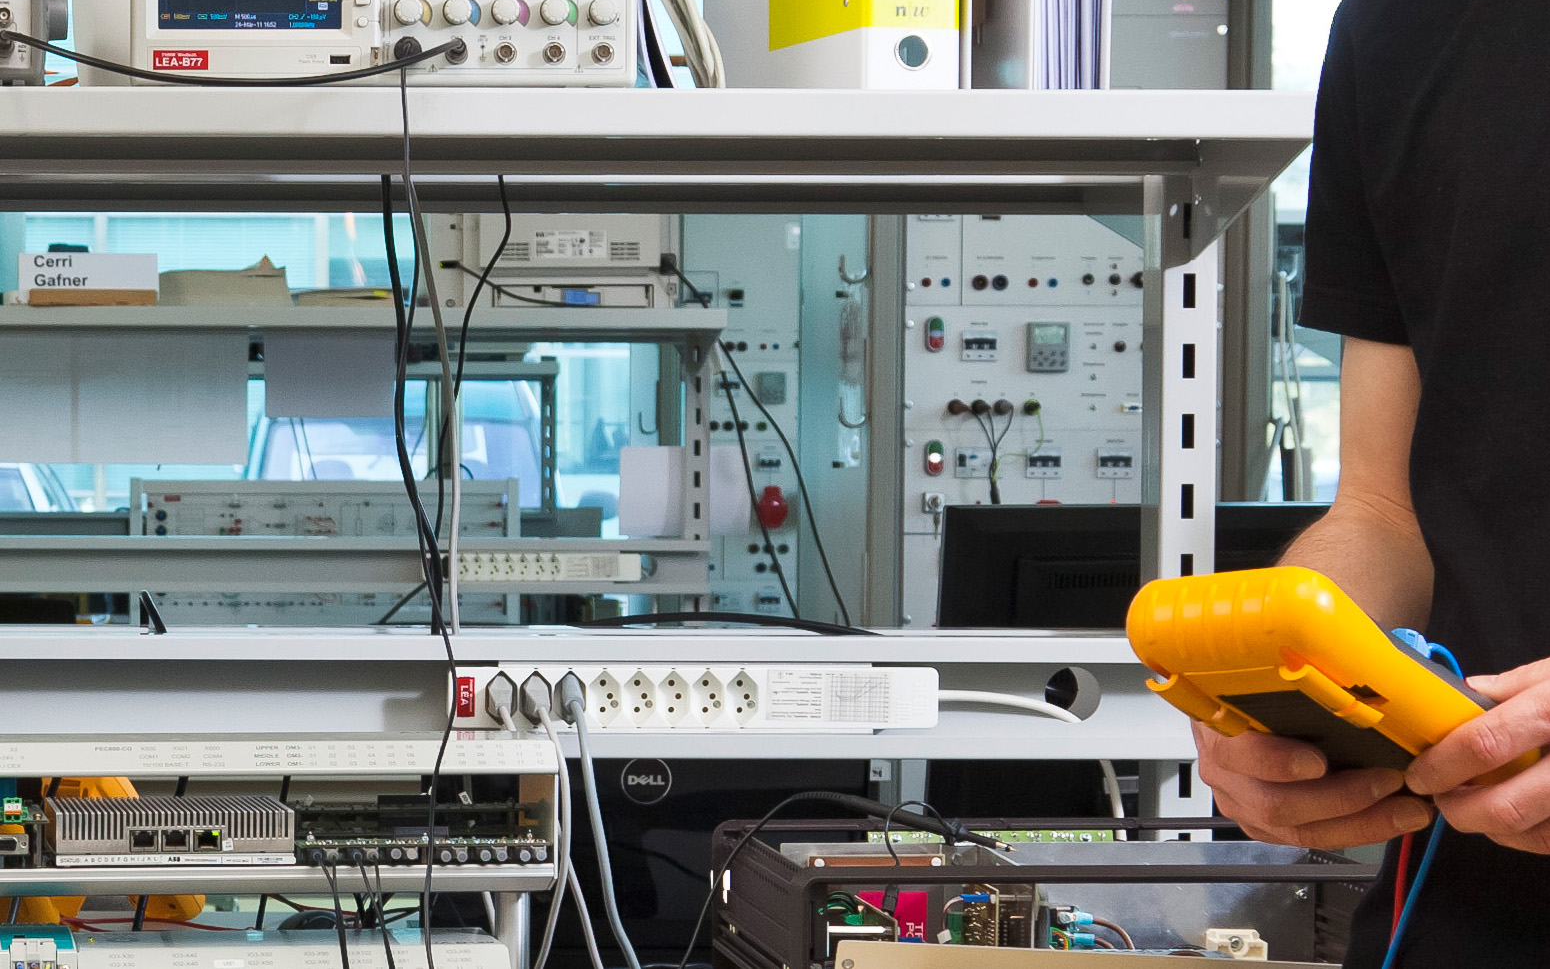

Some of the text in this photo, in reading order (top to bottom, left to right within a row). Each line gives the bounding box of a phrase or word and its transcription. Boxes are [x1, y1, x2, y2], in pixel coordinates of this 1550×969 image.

[155, 57, 203, 67] LEA-B77
[33, 255, 72, 268] Cerri
[34, 273, 88, 287] Gafner
[460, 685, 470, 706] LEA
[627, 774, 665, 786] DELL
